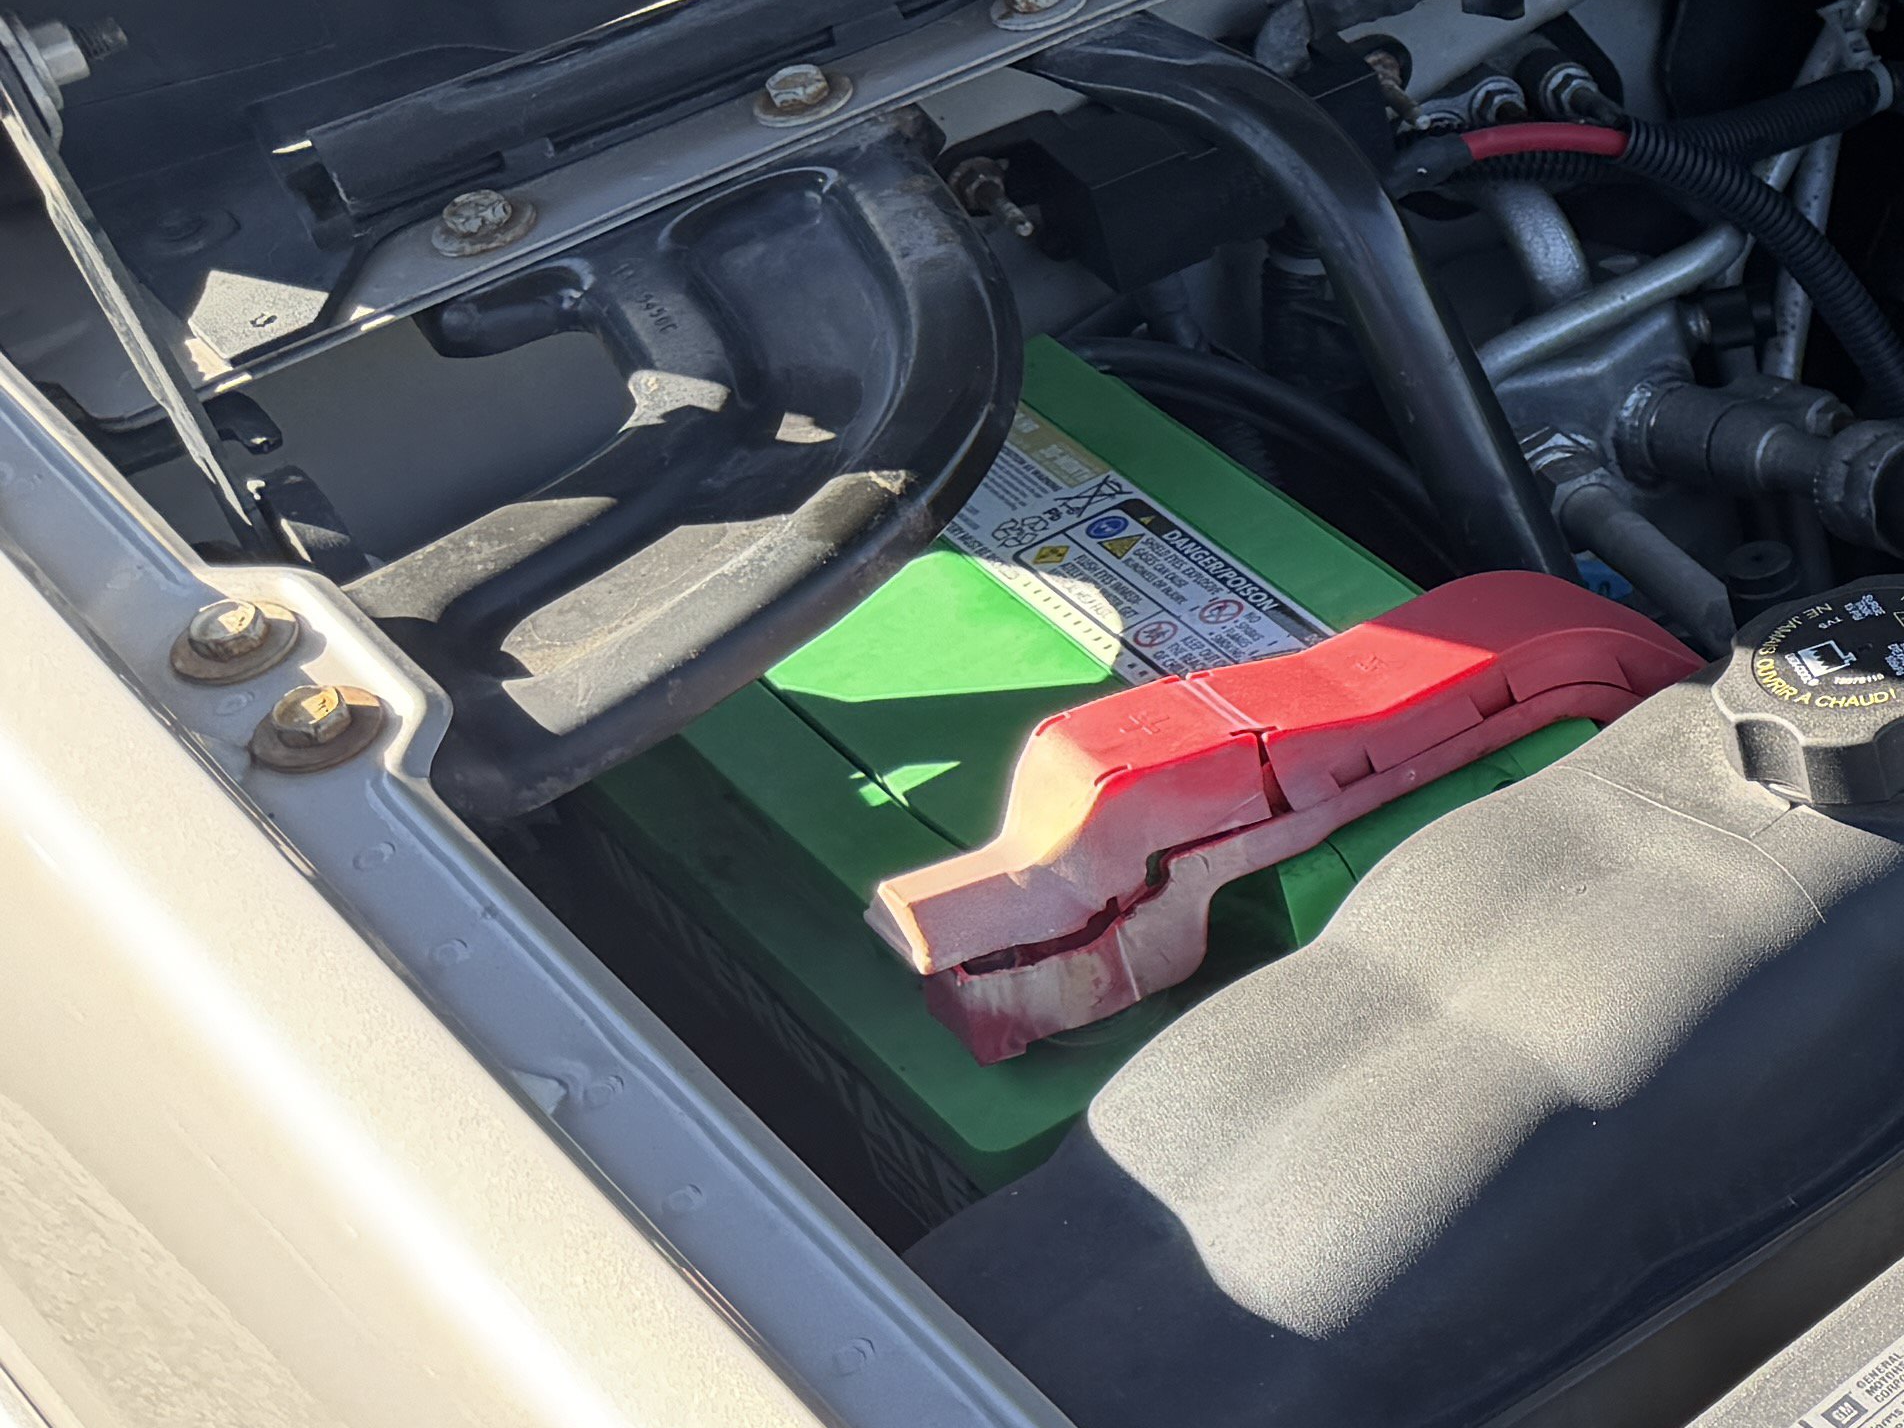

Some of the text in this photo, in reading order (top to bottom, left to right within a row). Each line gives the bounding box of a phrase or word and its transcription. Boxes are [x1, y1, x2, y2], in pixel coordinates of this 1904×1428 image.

[1161, 528, 1282, 612] DANGER/POISON
[1803, 602, 1833, 620] NE
[1759, 615, 1803, 656] JAMAIS
[1756, 657, 1799, 701] OUVRIR
[1814, 687, 1897, 709] CHAUD!
